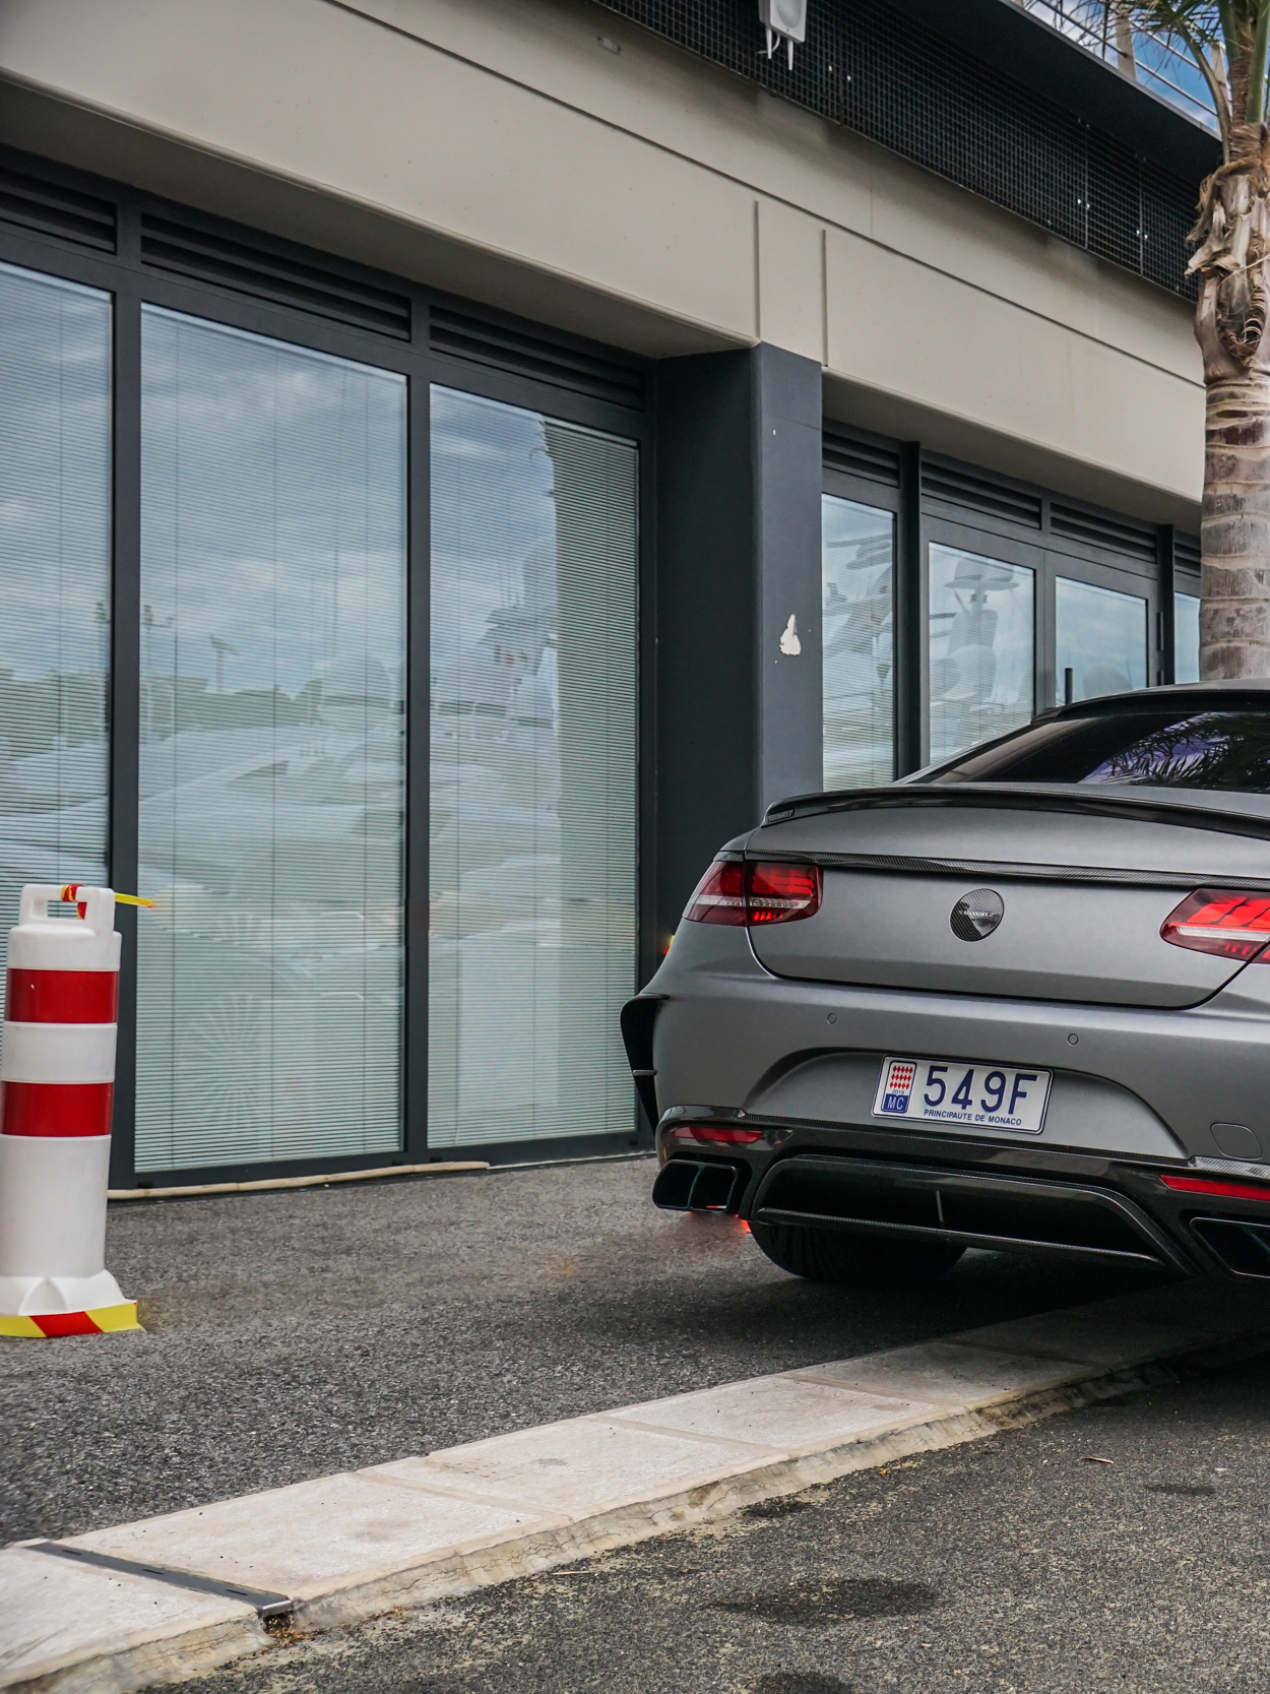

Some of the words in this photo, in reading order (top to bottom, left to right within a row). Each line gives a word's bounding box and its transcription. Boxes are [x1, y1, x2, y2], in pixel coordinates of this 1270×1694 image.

[923, 1065, 1038, 1115] 549F
[887, 1096, 904, 1110] MC
[924, 1109, 973, 1120] PRINCIPAUTE
[975, 1114, 986, 1122] DE
[988, 1115, 1022, 1126] MONACO
